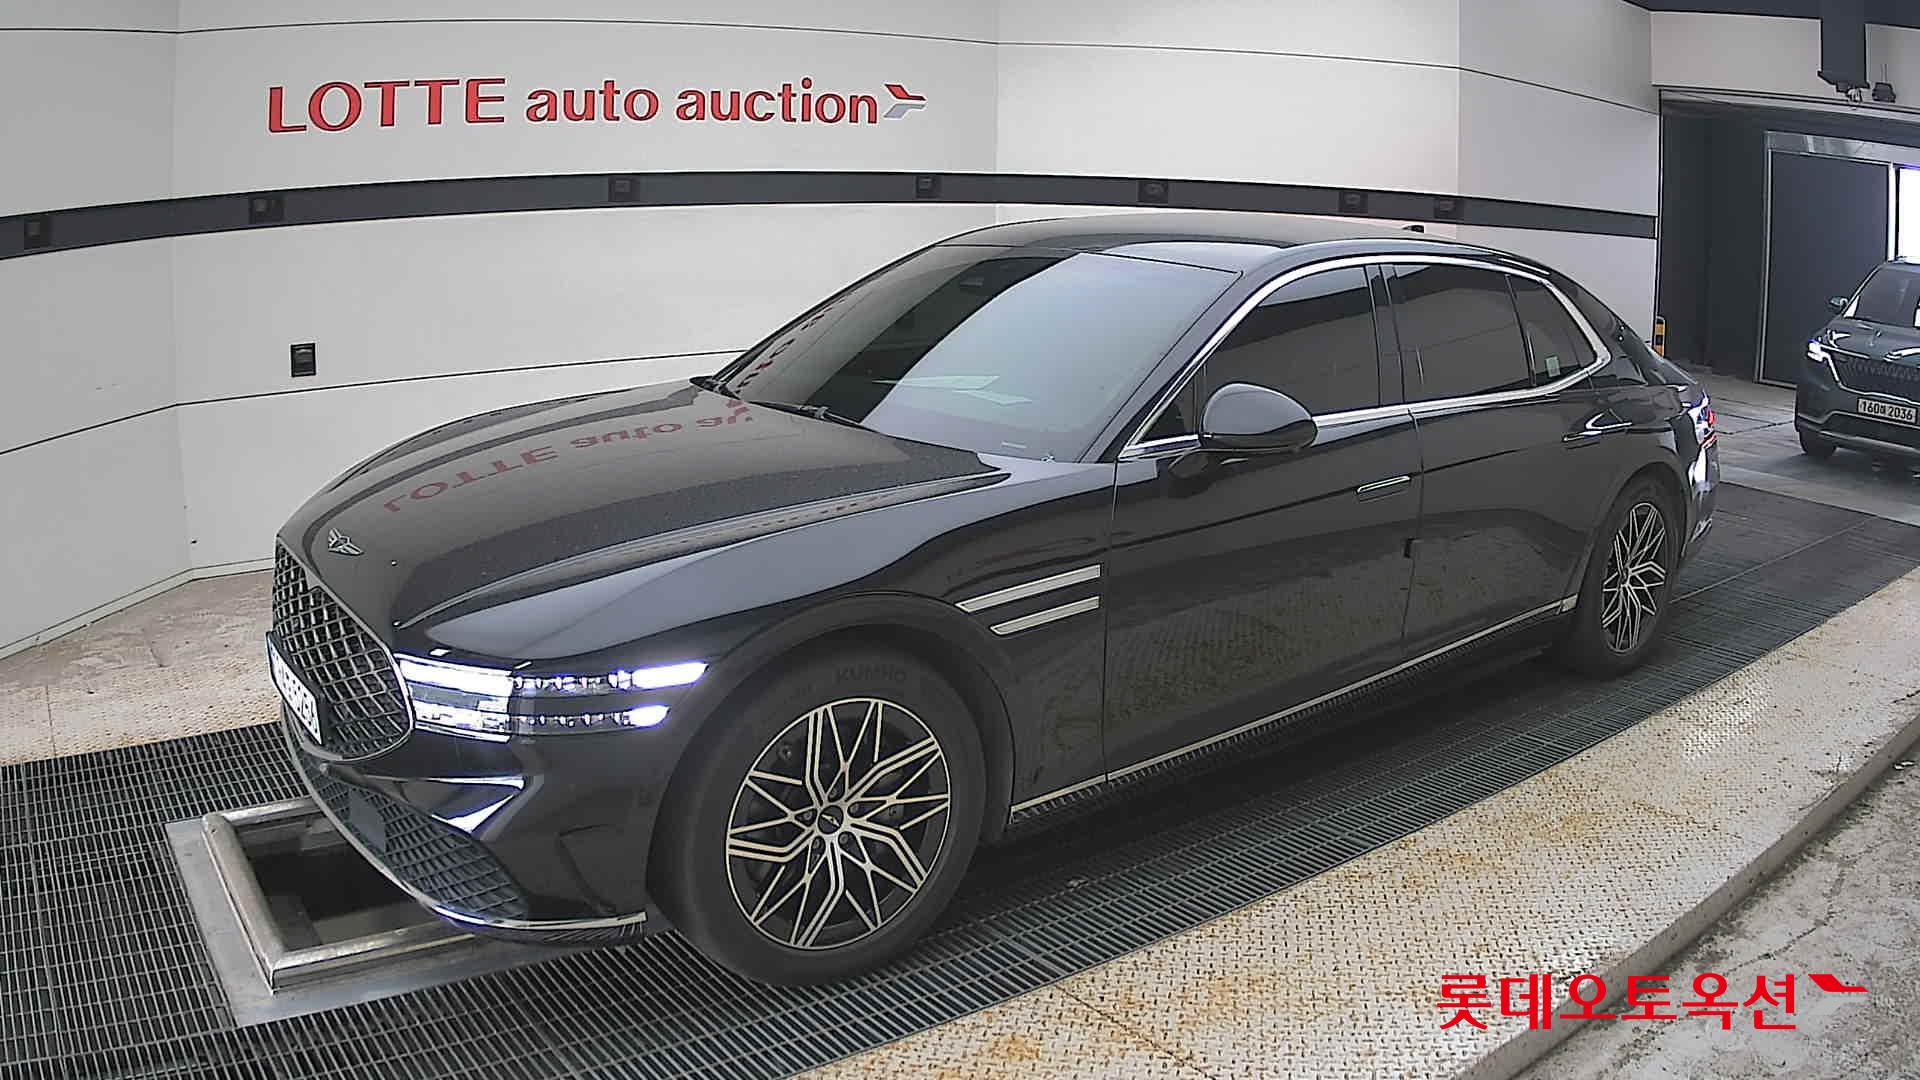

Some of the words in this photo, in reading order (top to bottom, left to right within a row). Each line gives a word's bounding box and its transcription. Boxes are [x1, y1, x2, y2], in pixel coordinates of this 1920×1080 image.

[268, 78, 505, 133] LOTTE
[525, 80, 659, 122] auto
[676, 78, 879, 124] auction
